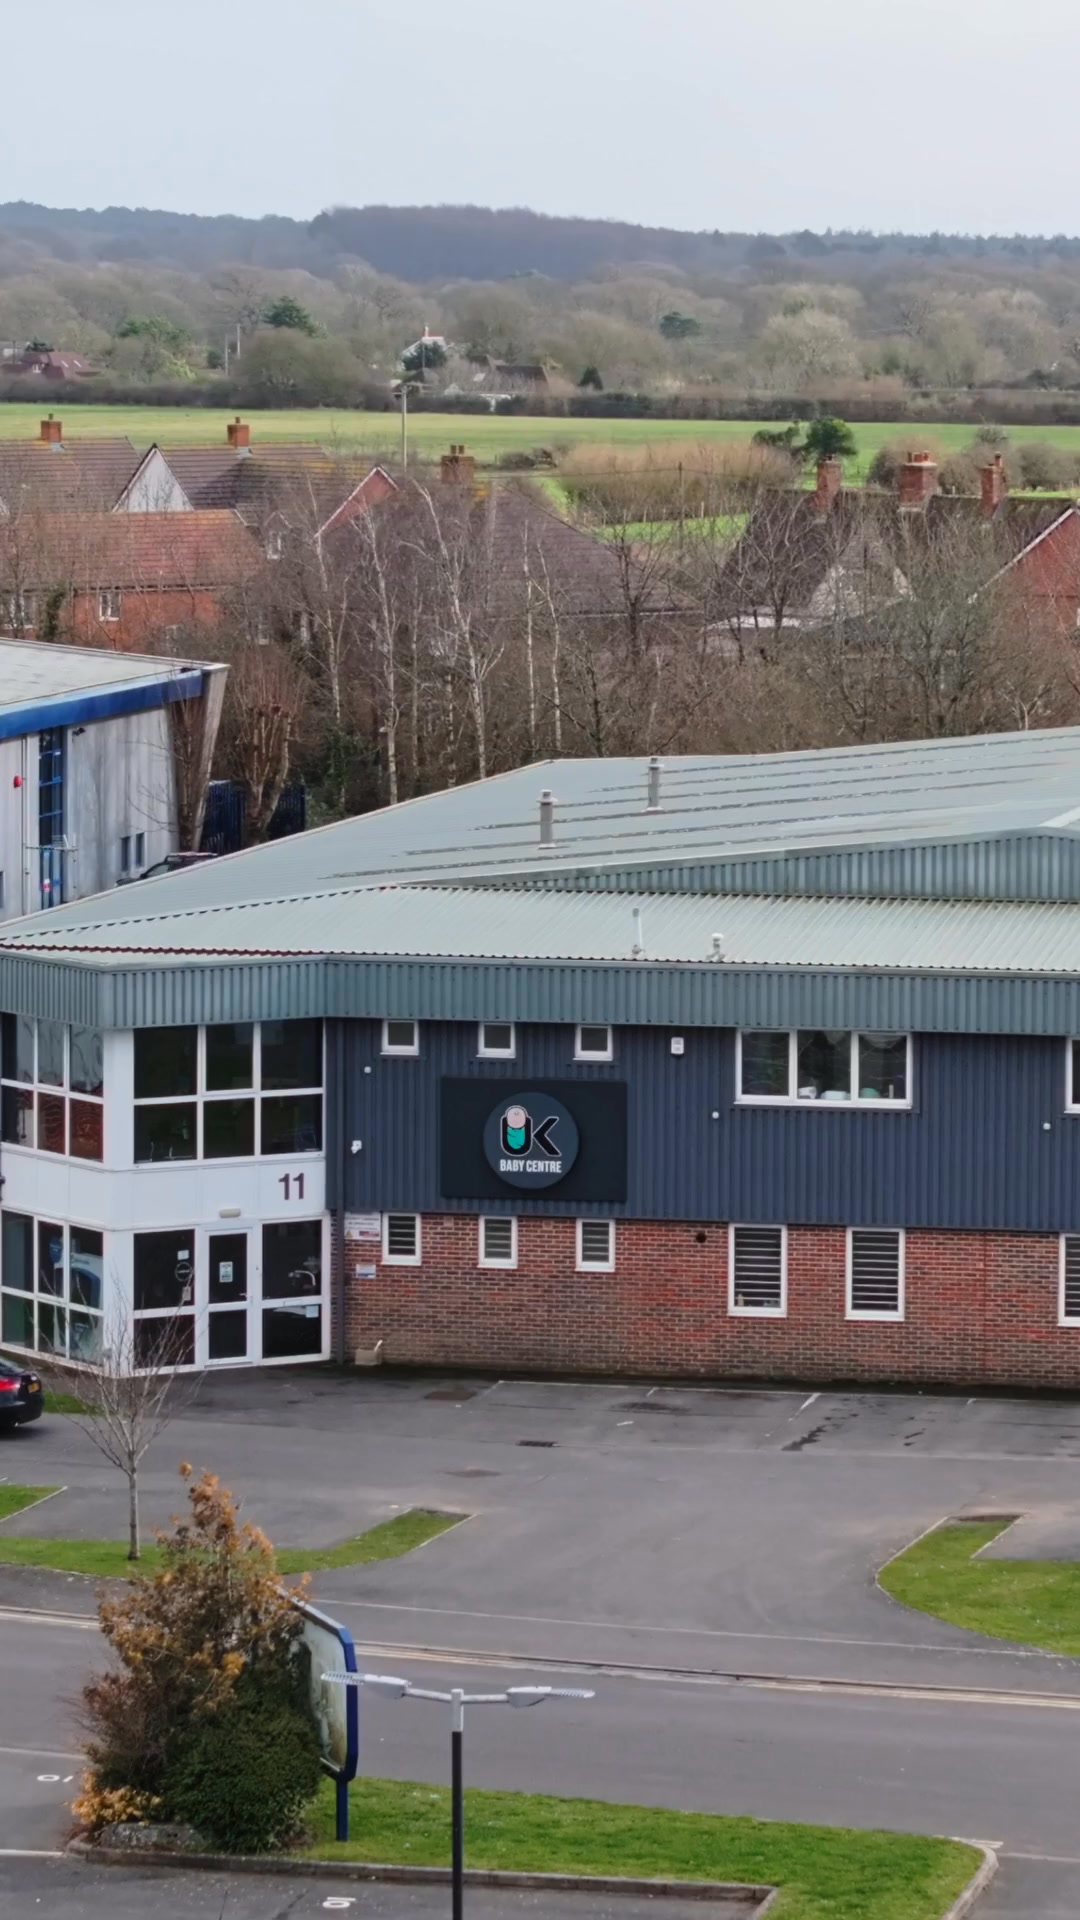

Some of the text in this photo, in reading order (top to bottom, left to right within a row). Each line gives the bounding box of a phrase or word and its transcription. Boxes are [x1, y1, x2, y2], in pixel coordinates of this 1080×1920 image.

[500, 1106, 562, 1157] UK
[500, 1159, 562, 1173] BABY CENTRE
[278, 1172, 304, 1200] 11
